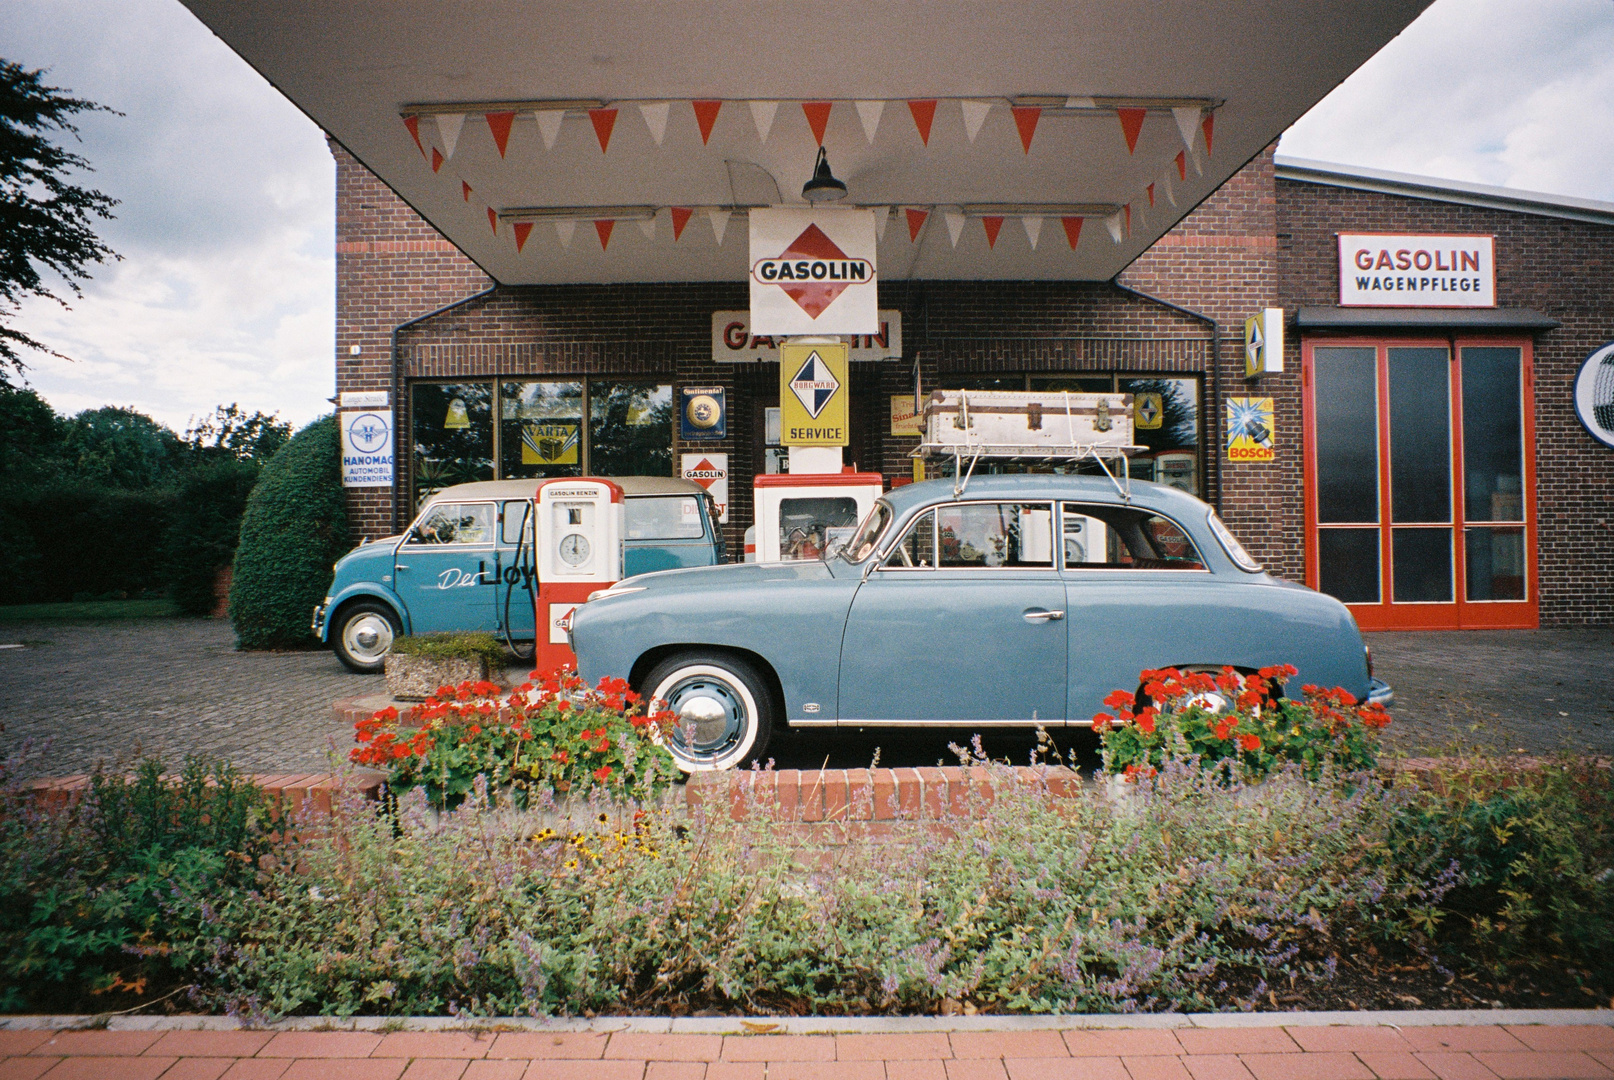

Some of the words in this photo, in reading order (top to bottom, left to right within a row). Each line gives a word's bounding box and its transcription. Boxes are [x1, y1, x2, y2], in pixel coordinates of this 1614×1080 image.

[1354, 249, 1480, 272] GASOLIN
[760, 261, 866, 280] GASOLIN
[1354, 276, 1482, 292] WAGENPFLEGE
[793, 381, 836, 389] BORGWARD
[528, 426, 569, 436] VARTA
[790, 428, 842, 439] SERVICE
[1229, 447, 1273, 459] BOSCH
[349, 467, 390, 475] AUTOMOBIL
[343, 475, 393, 483] KUNDENDIENS
[438, 567, 490, 590] Der
